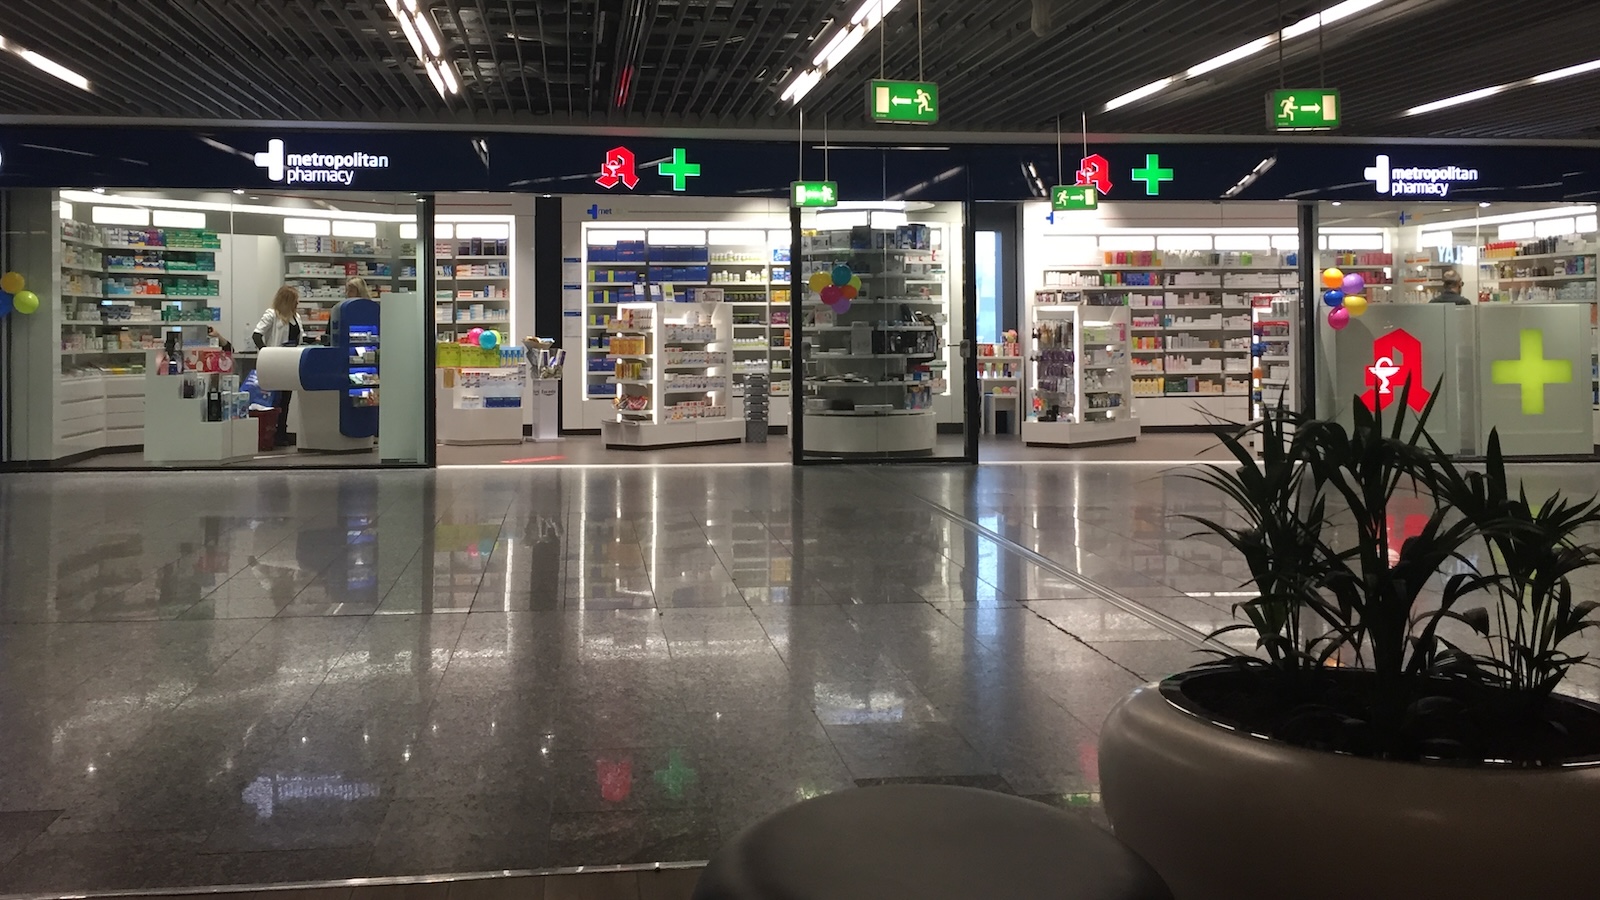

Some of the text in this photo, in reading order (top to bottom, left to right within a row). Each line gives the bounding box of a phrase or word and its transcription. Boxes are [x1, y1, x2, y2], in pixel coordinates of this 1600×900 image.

[287, 152, 389, 170] metropolitan
[287, 166, 354, 185] pharmacy
[1392, 166, 1478, 183] metropolitan
[1392, 179, 1449, 197] pharmacy
